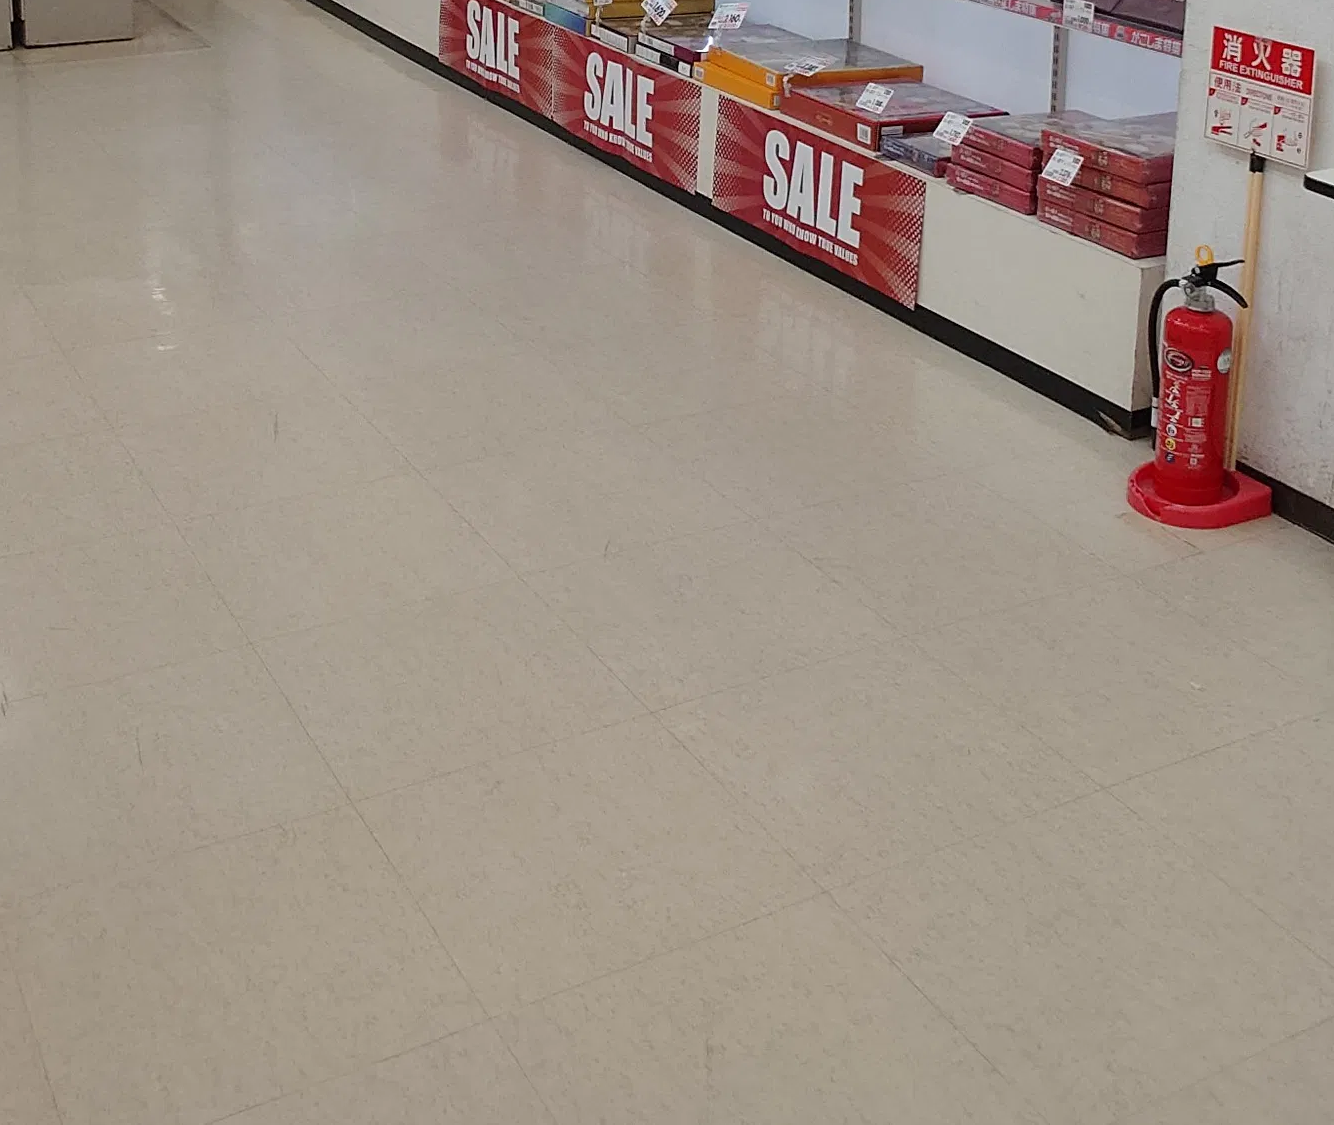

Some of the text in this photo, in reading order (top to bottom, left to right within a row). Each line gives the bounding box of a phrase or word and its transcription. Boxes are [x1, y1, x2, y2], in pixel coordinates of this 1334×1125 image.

[466, 0, 520, 81] SALE
[1219, 60, 1303, 90] FIRE EXTINGUISHER
[1223, 33, 1302, 77] 消火器
[584, 52, 655, 148] SALE
[763, 130, 864, 249] SALE
